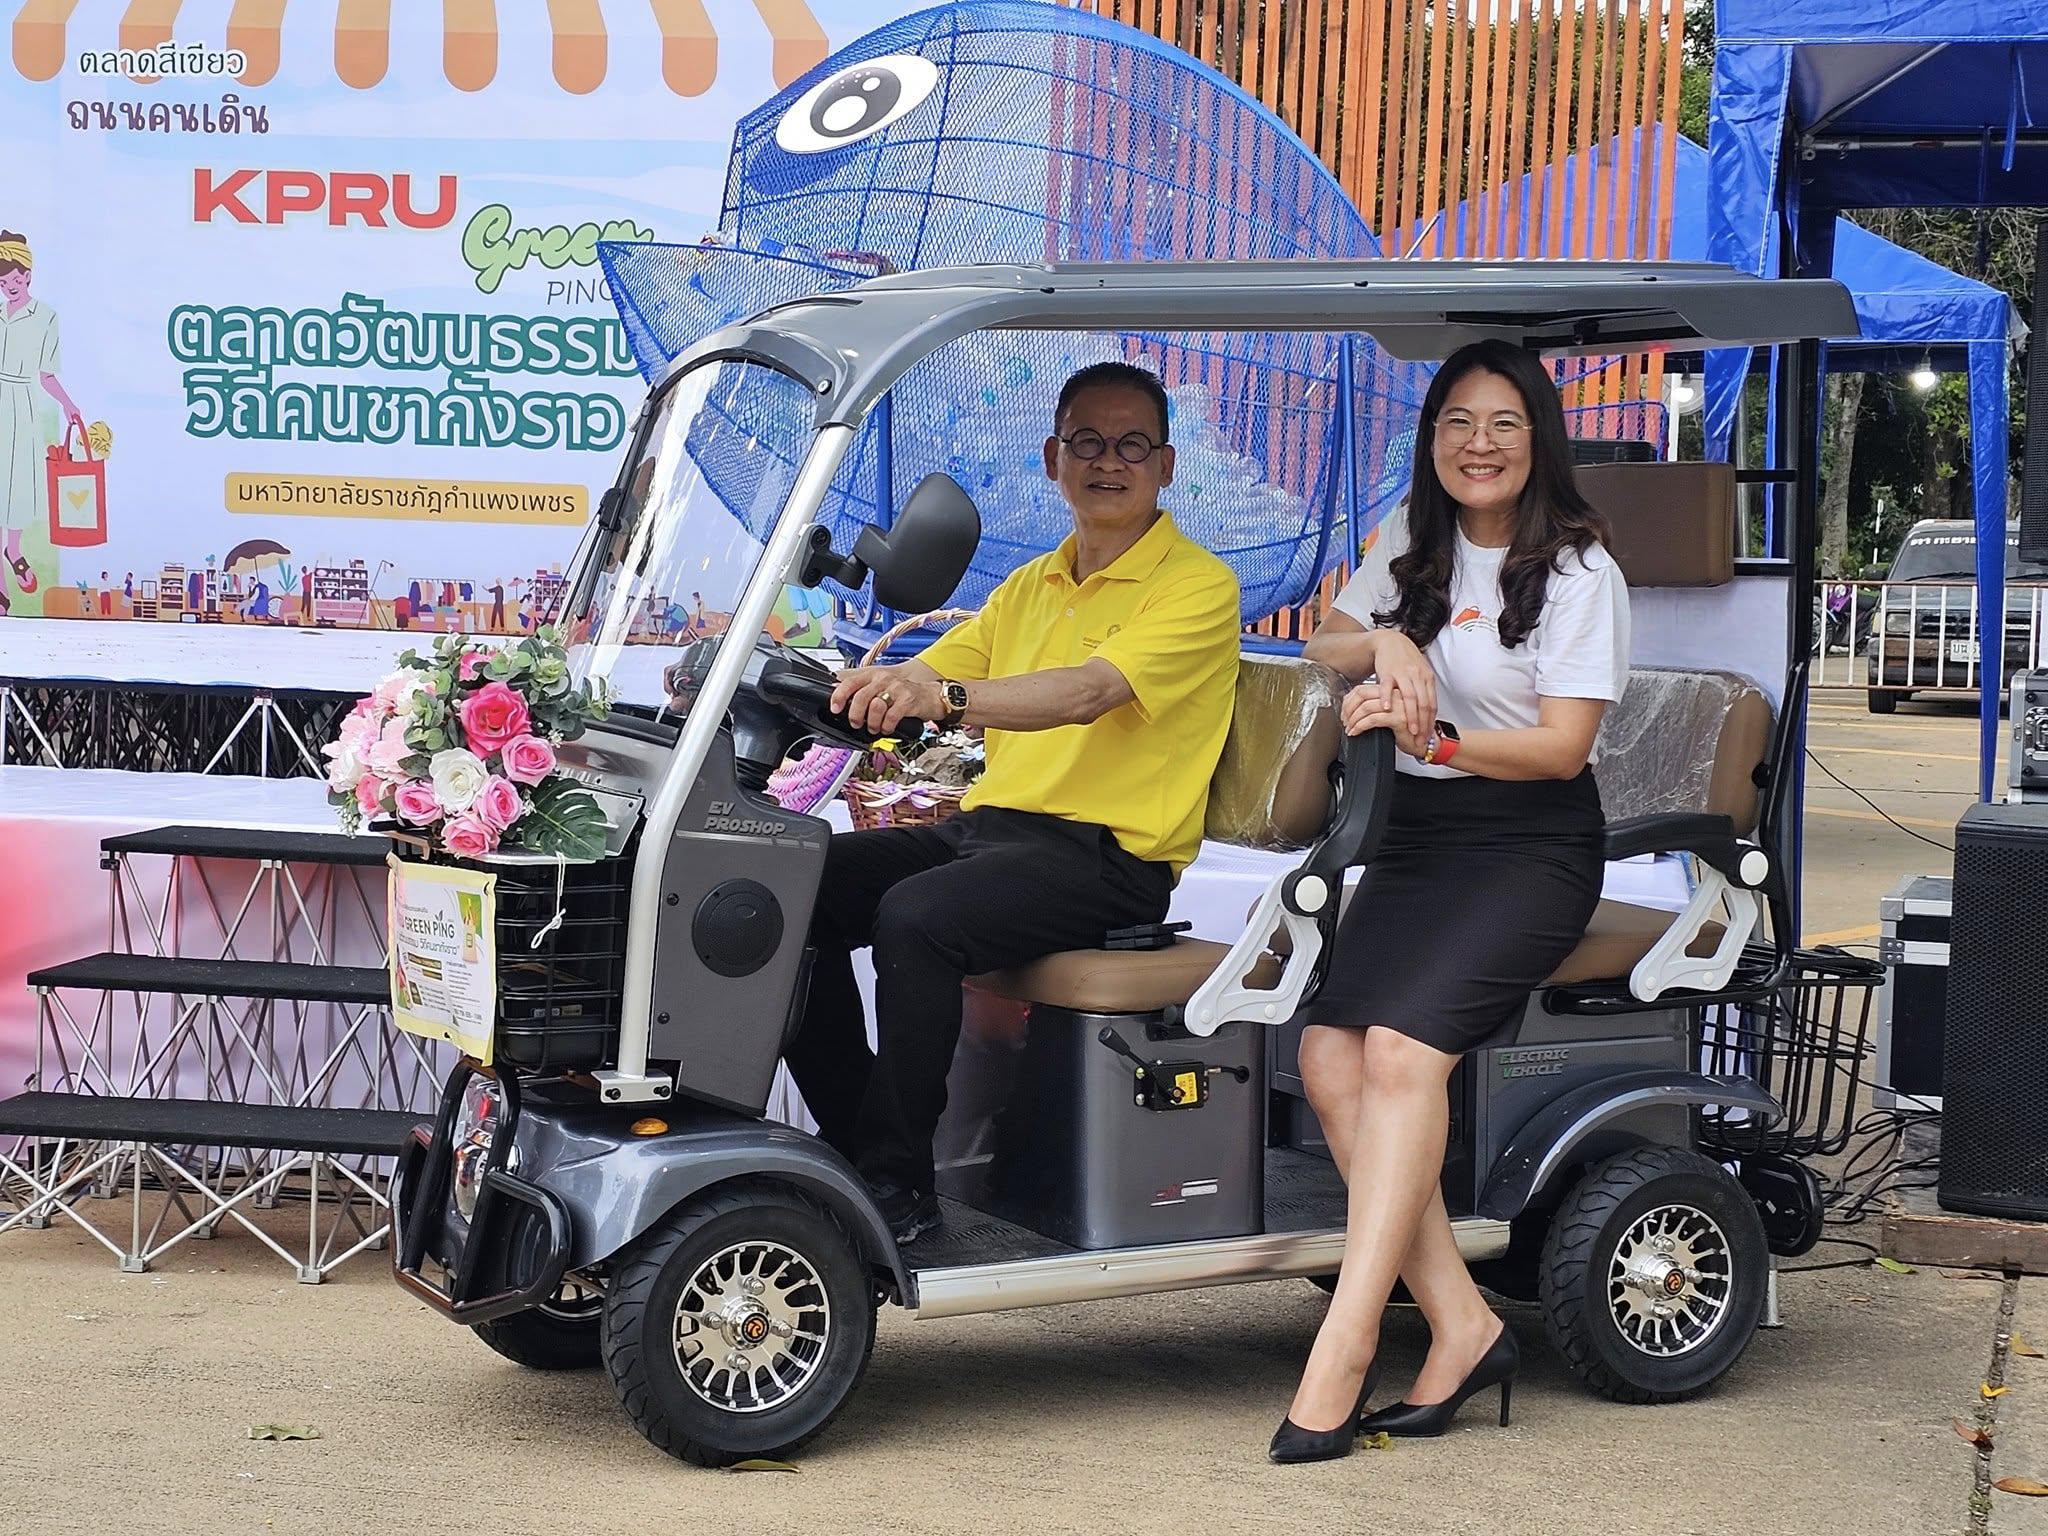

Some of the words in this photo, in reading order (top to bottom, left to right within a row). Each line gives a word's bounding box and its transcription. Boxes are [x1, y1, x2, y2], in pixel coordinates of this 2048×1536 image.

[79, 43, 244, 75] ตลาดสีเขียว
[66, 93, 270, 135] ถนนคนเดิน
[193, 168, 458, 230] KPRU
[169, 293, 641, 375] ตลาดวัฒนธรรม
[185, 369, 624, 450] วิถีคนชากังราว
[708, 801, 735, 816] EV
[704, 816, 786, 837] PROSHOP
[404, 916, 431, 936] GREEN
[432, 920, 455, 939] PING
[1500, 1049, 1570, 1065] ELECTRIC
[1503, 1063, 1564, 1079] VEHICLE
